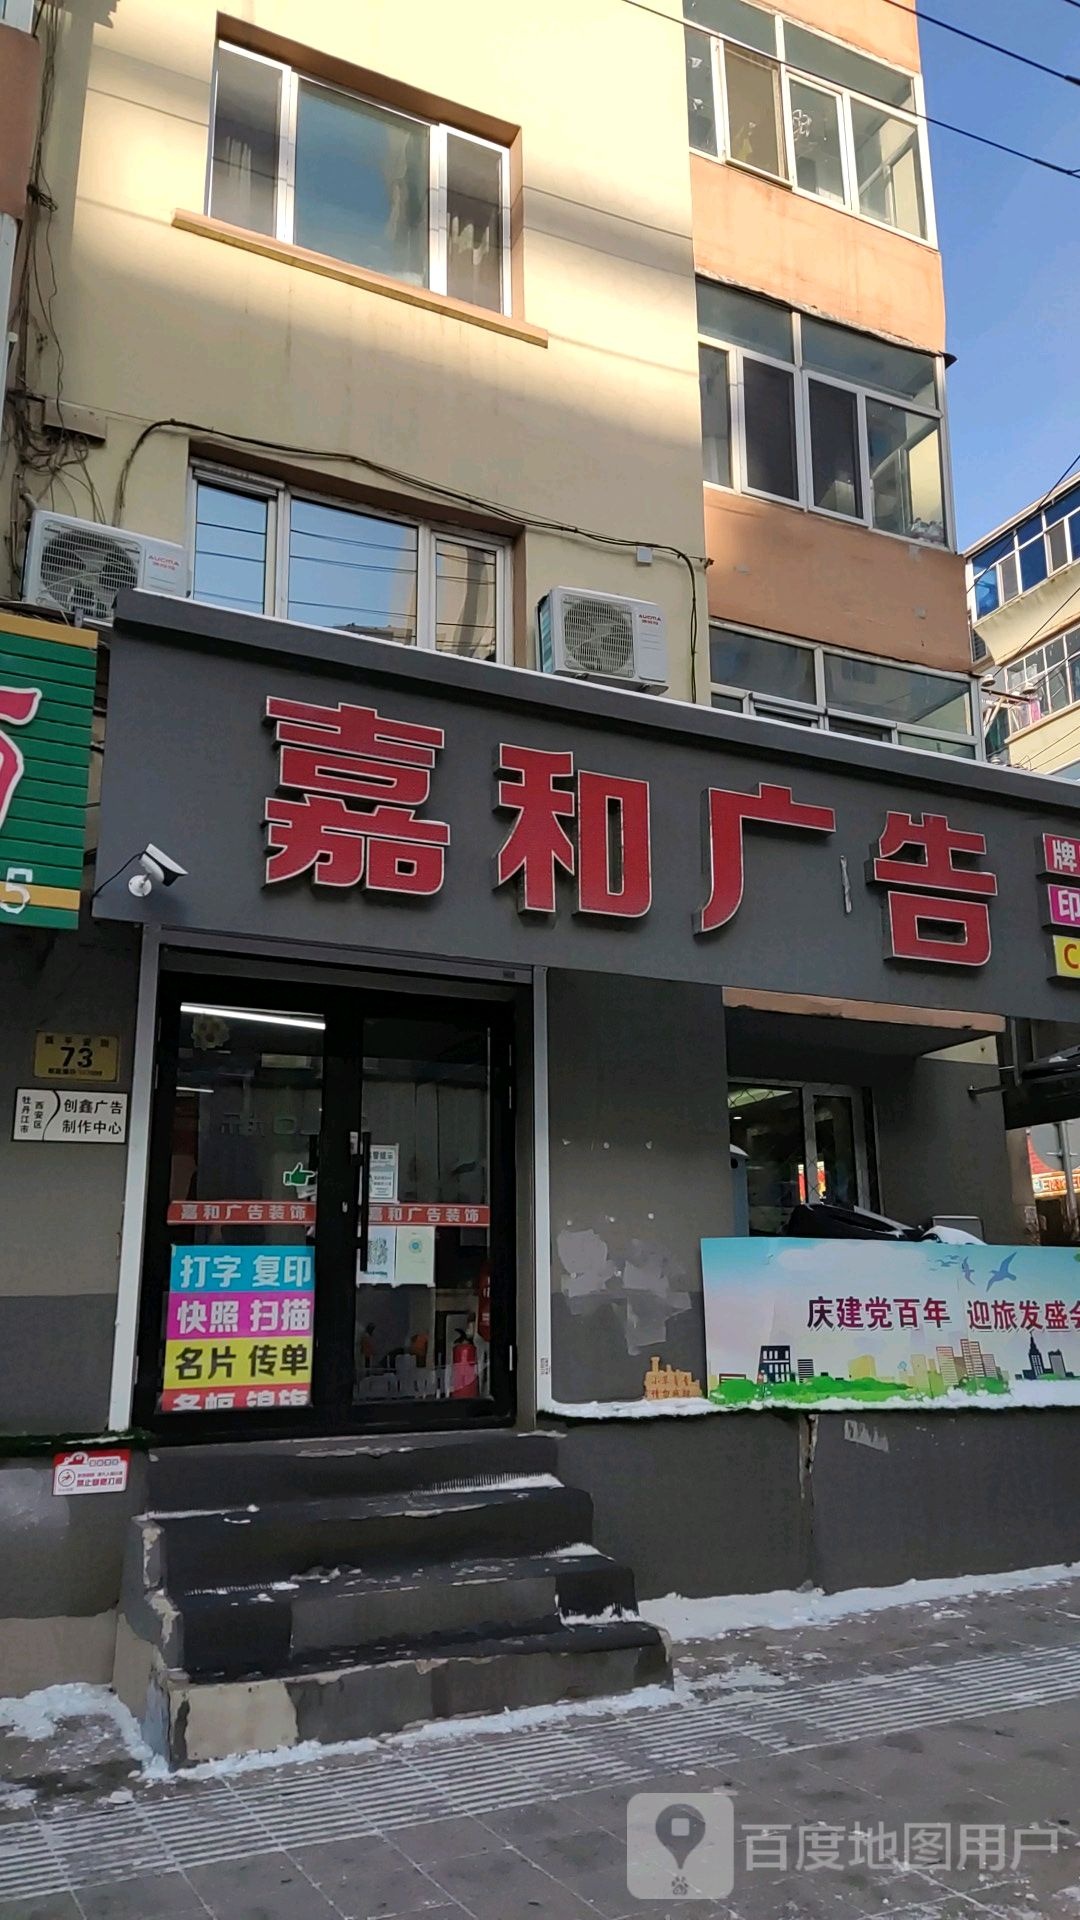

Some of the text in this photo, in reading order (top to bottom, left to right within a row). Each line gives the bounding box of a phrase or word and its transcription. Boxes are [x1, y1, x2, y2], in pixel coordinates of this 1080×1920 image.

[266, 696, 999, 967] 嘉和广告
[1063, 943, 1079, 969] C
[60, 1046, 93, 1068] 73
[20, 1096, 31, 1133] 牡丹江市
[33, 1101, 44, 1129] 西安区
[63, 1099, 123, 1115] 创鑫广告
[62, 1119, 122, 1135] 制作中心
[181, 1204, 306, 1220] 嘉和广告装饰
[180, 1255, 312, 1288] 打字 复印
[177, 1298, 311, 1334] 快照 扫描
[807, 1296, 950, 1329] 庆建党百年
[175, 1344, 309, 1380] 名片 传单
